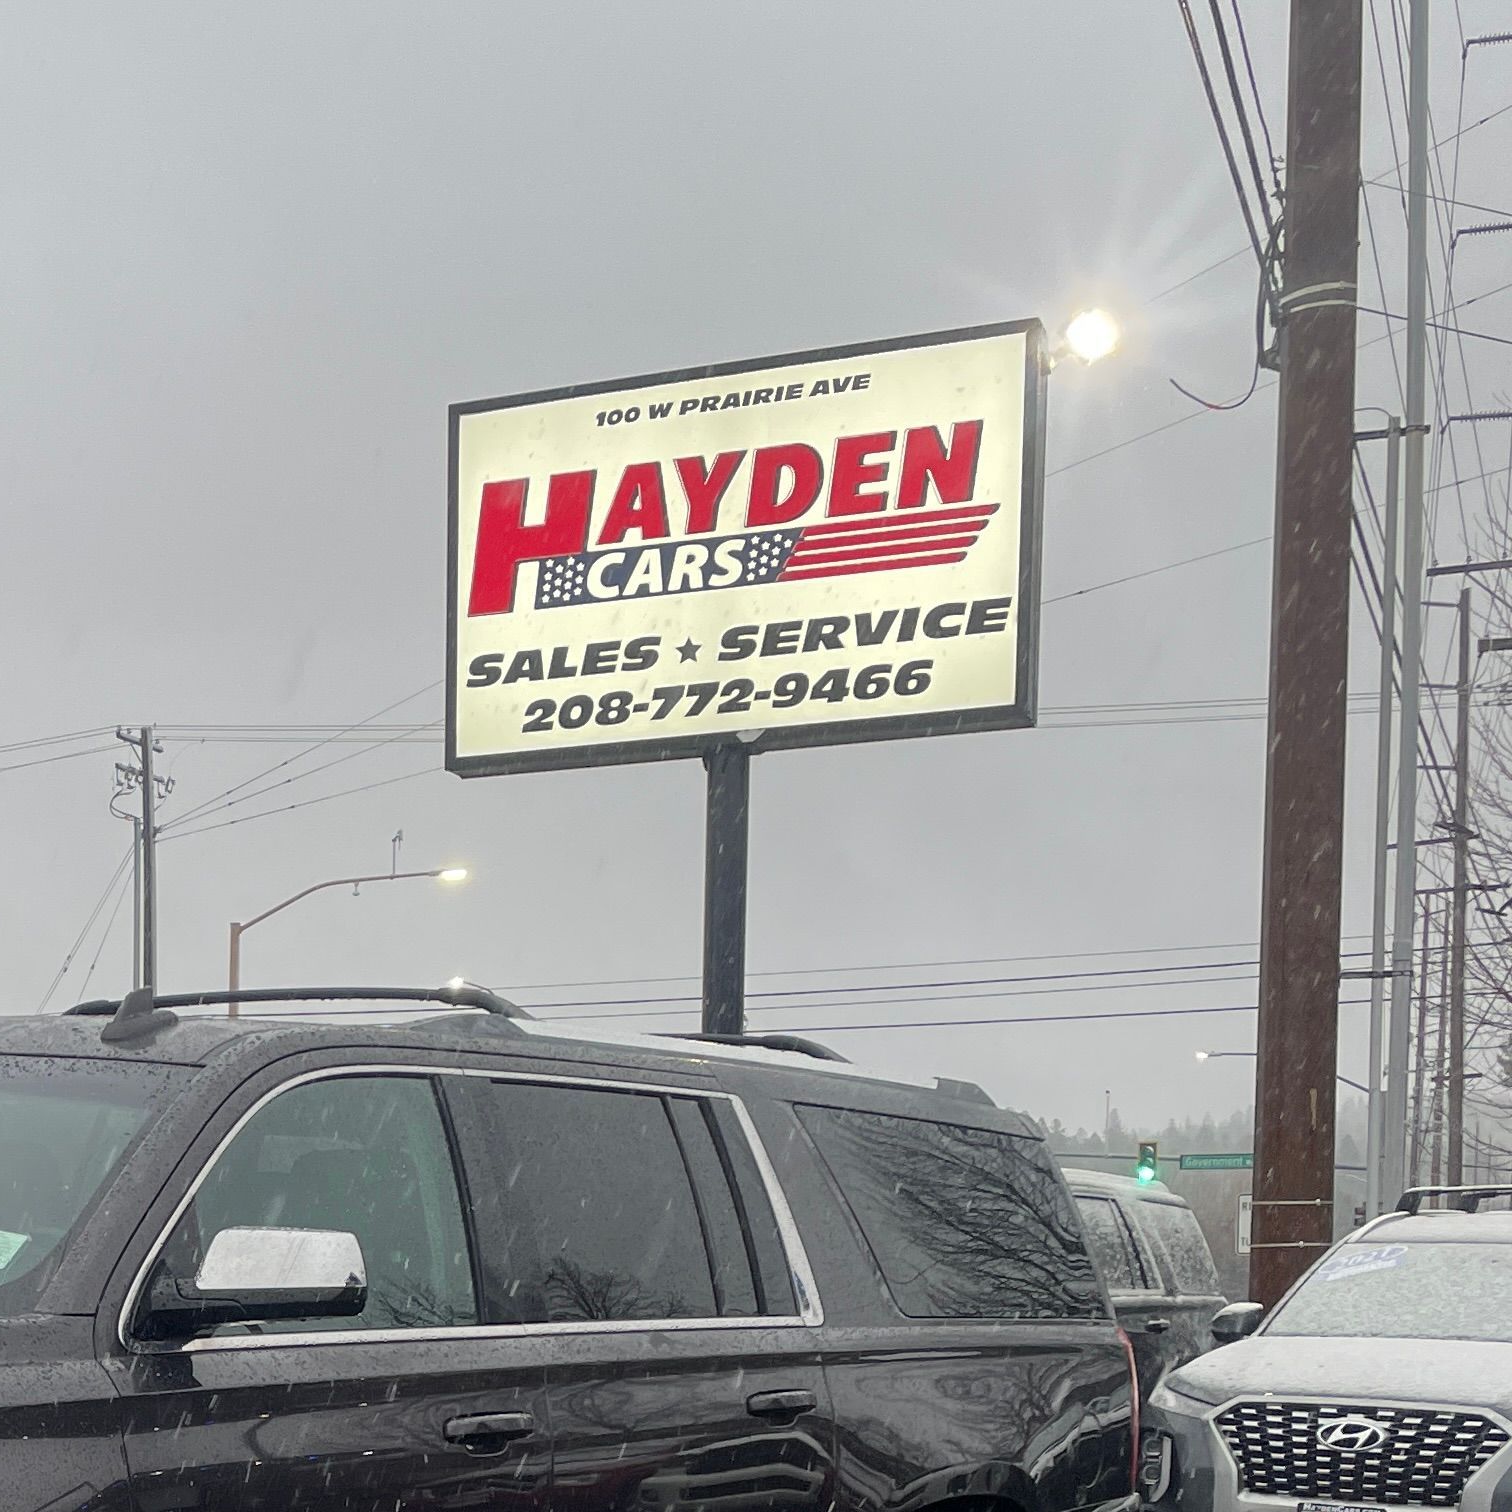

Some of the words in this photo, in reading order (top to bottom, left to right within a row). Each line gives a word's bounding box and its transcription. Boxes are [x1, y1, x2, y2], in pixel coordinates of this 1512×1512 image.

[596, 407, 641, 427] 100
[649, 402, 675, 420] W
[679, 383, 805, 416] PRAIRIE
[809, 373, 872, 398] AVE
[468, 420, 984, 617] HAYDEN
[585, 537, 747, 600] CARS
[466, 636, 661, 688] SALES
[717, 597, 1013, 662] SERVICE
[521, 659, 934, 734] 208-772-9466
